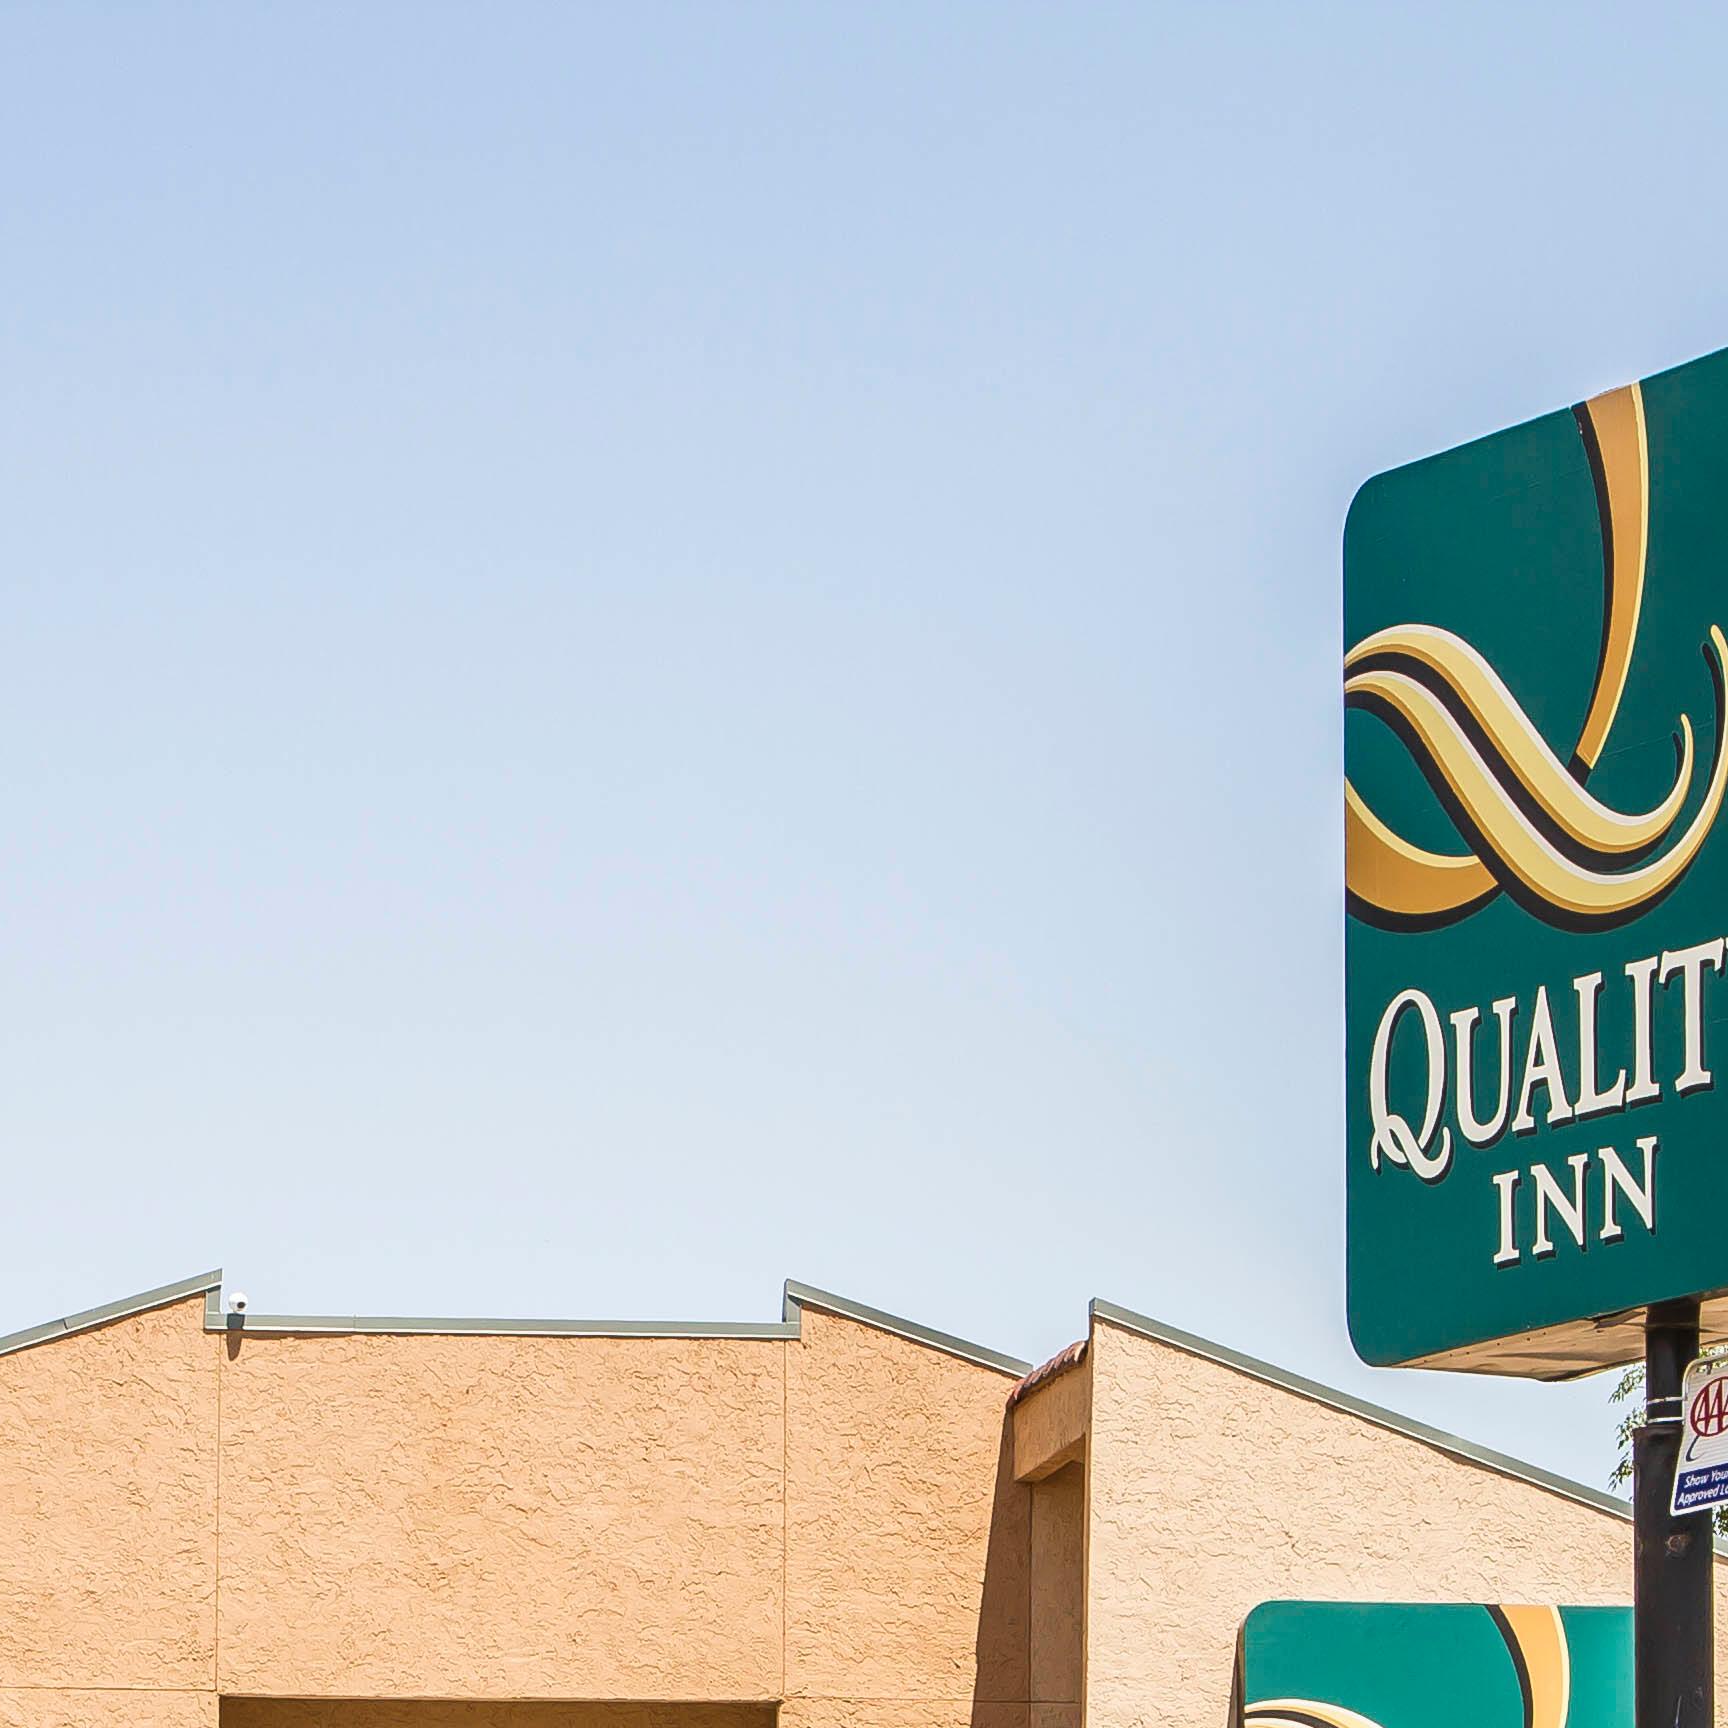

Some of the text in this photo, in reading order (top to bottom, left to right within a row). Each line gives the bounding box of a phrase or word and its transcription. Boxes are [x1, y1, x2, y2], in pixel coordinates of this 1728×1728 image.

[1492, 1135, 1659, 1268] INN
[1683, 1474, 1710, 1489] Show
[1677, 1484, 1721, 1507] Approved
